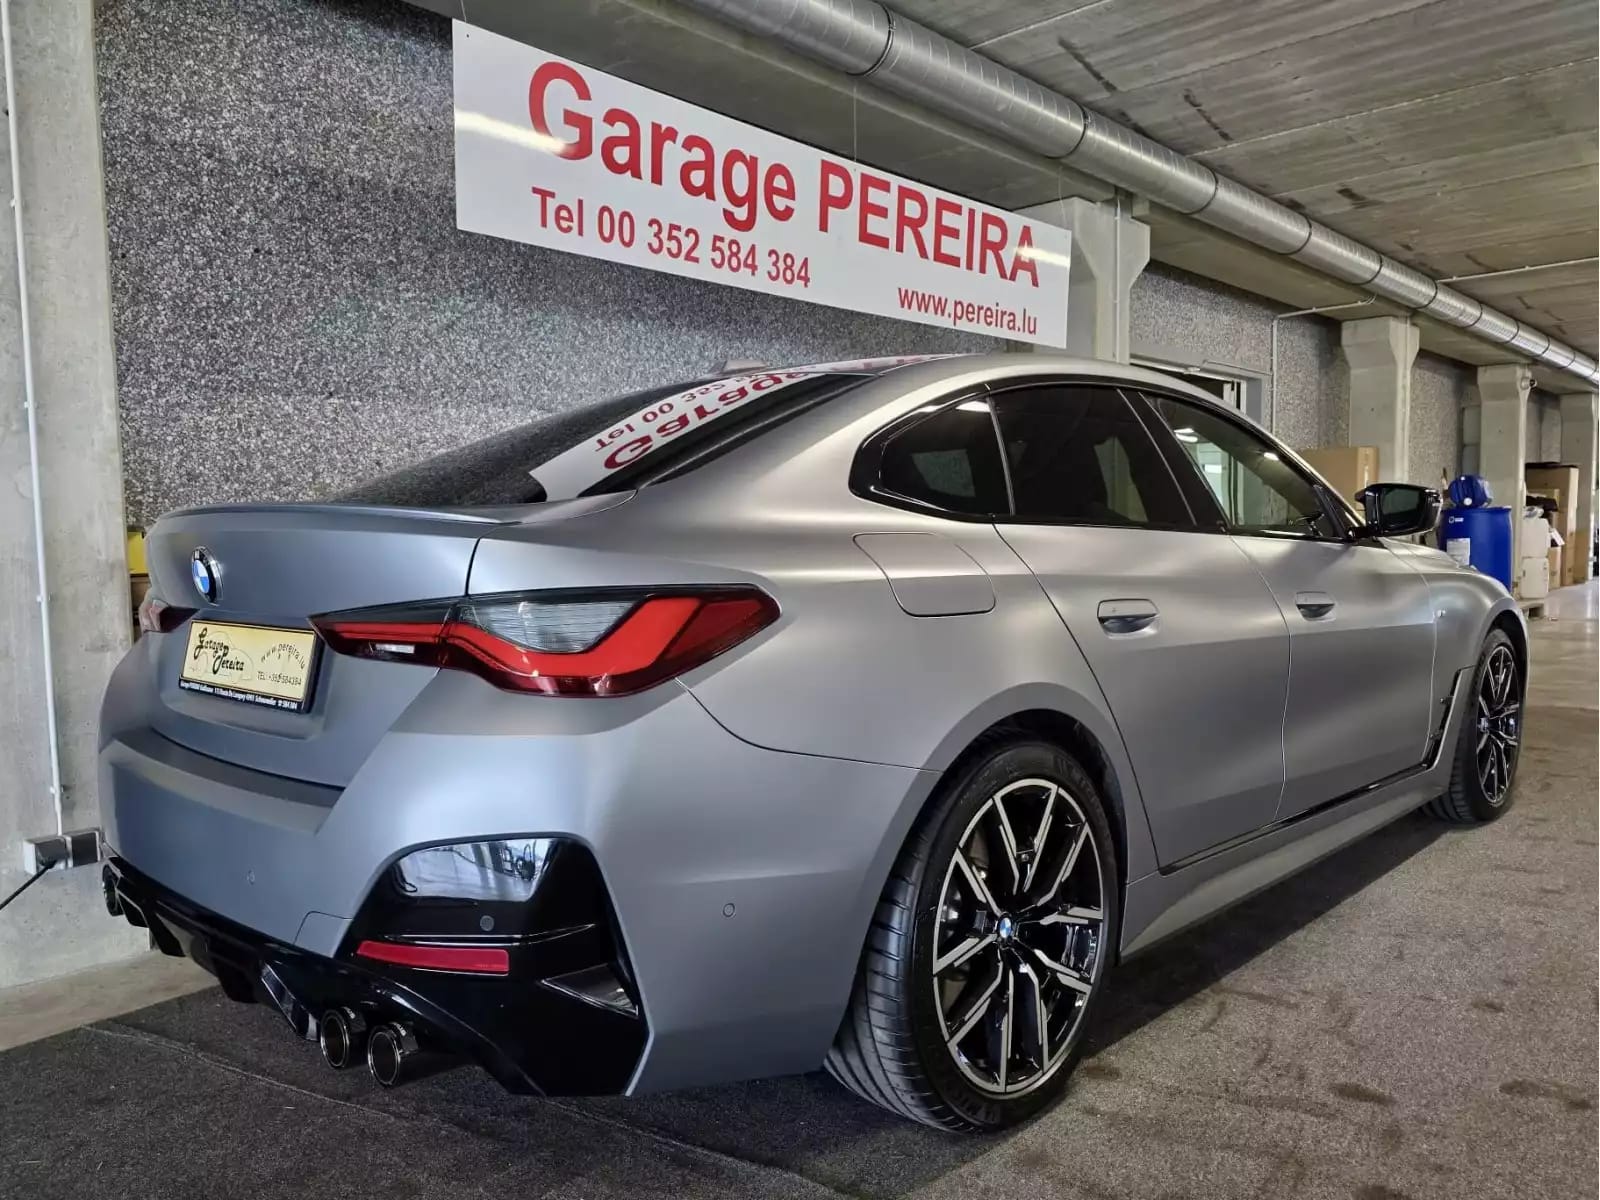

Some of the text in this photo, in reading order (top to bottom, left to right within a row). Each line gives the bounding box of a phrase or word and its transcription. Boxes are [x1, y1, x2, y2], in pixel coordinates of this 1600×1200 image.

[529, 61, 1039, 288] Garage PEREIRA
[532, 186, 810, 288] Tel 00 352 584 384
[898, 287, 1037, 335] www.pereira.lu
[193, 627, 224, 660] Garage
[212, 645, 245, 675] Pereira
